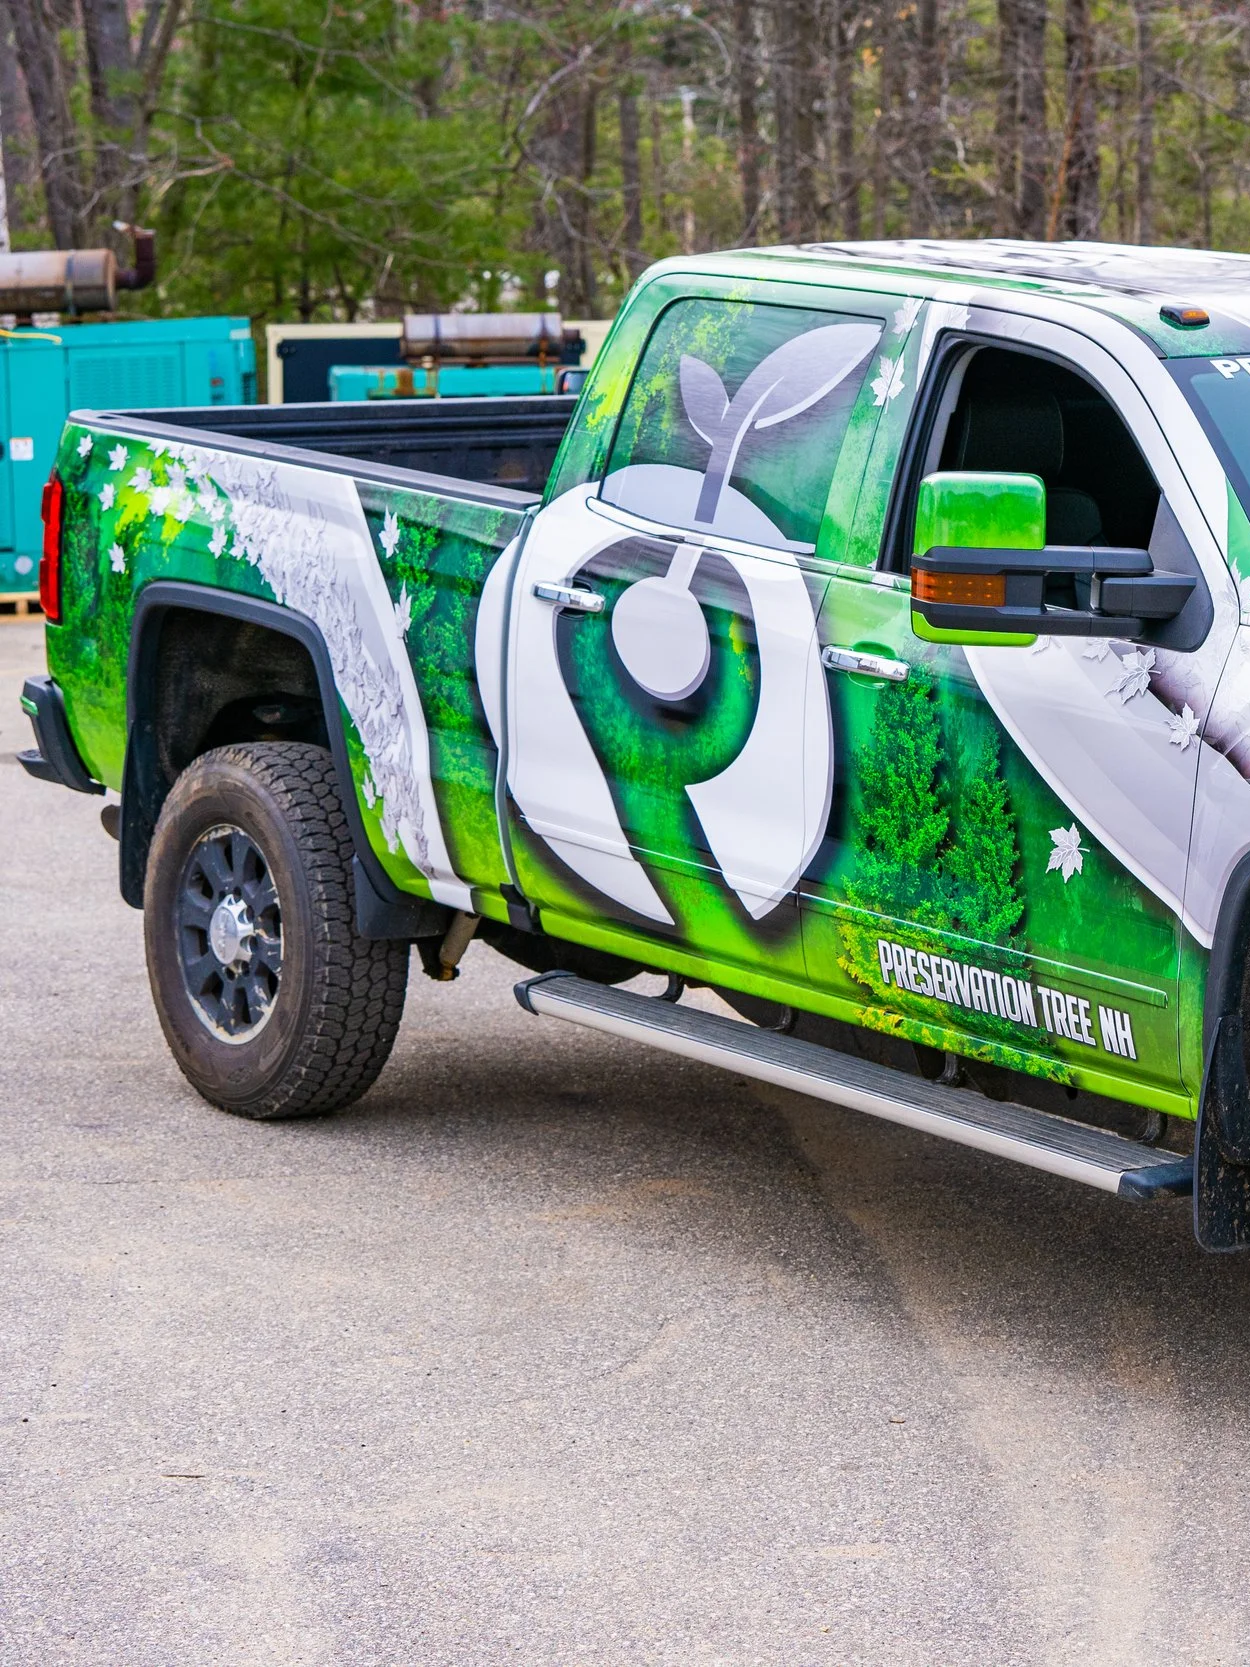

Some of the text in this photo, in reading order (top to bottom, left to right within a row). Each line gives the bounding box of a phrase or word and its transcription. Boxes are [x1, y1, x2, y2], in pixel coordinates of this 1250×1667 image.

[877, 939, 1137, 1060] PRESERVATION TREE NH
